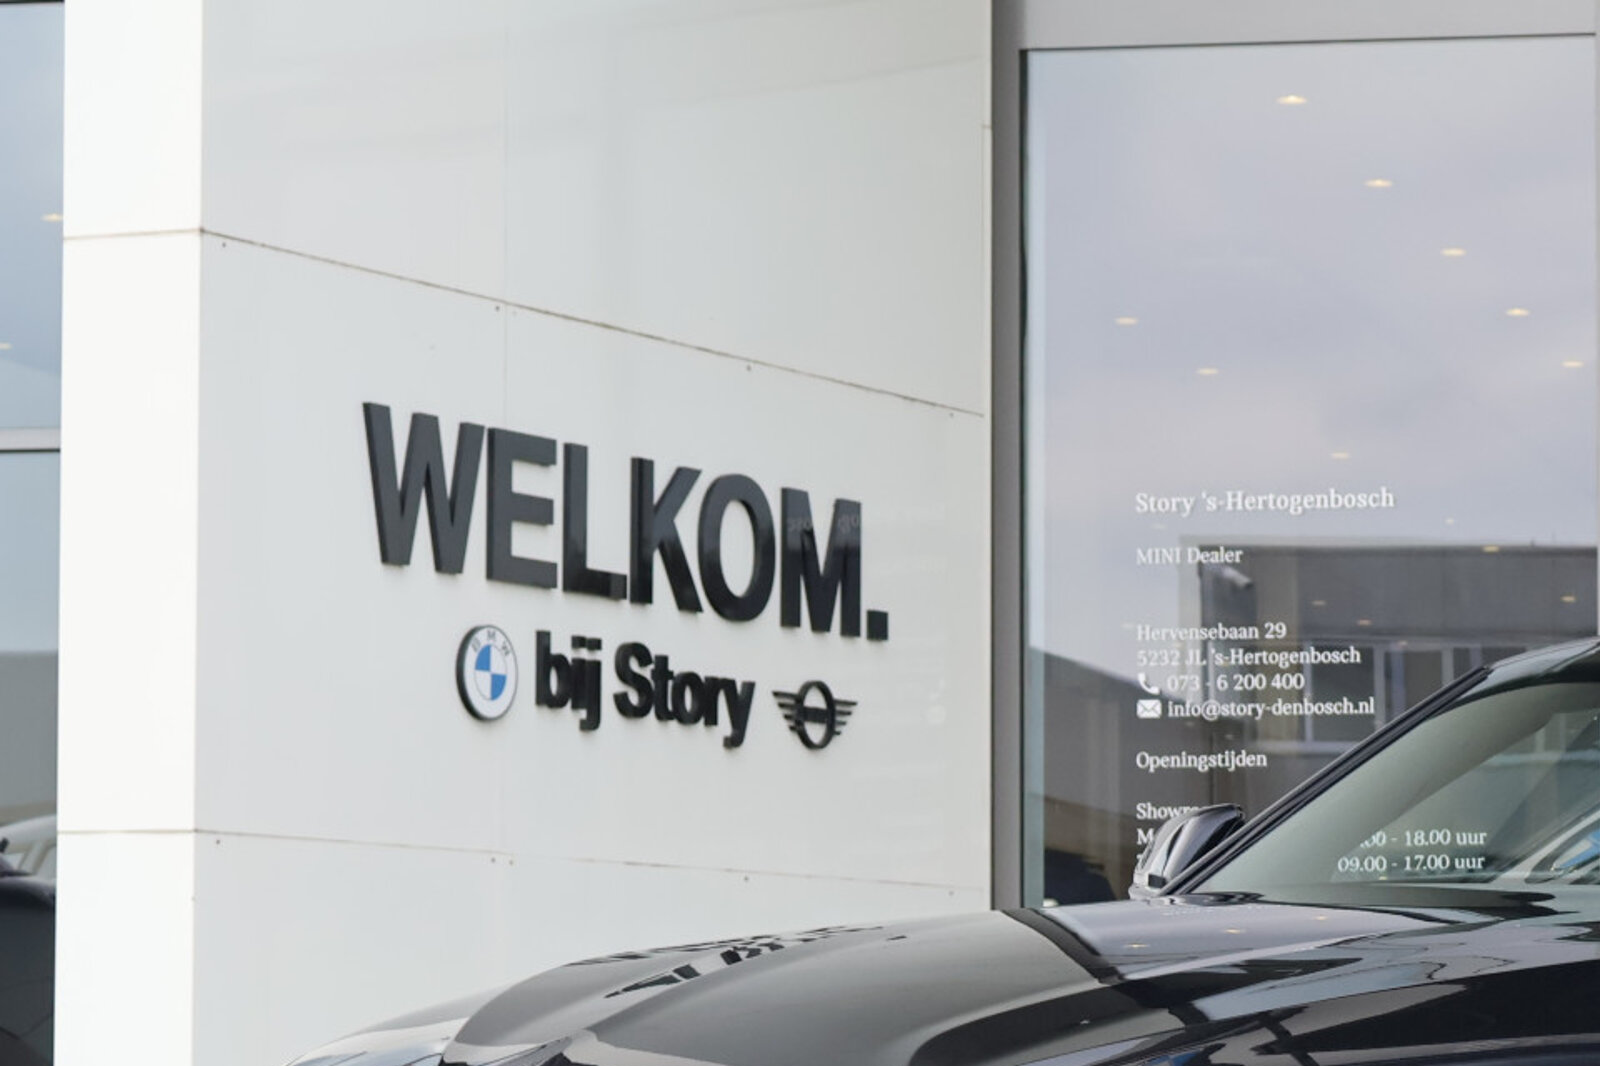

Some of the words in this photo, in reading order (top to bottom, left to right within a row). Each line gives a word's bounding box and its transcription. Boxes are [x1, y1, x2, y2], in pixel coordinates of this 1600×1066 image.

[1135, 492, 1196, 518] Story
[1201, 486, 1395, 515] 's-Hertogenbosch
[362, 401, 888, 641] WELKOM.
[1136, 547, 1182, 565] MINI
[1187, 546, 1243, 563] Dealer
[1137, 622, 1259, 641] Hervensebaan
[1264, 621, 1287, 639] 29
[1137, 650, 1180, 667] 5232
[1185, 649, 1207, 666] JL
[1211, 645, 1361, 669] 's-Hertogenbosch
[536, 630, 602, 731] bij
[612, 641, 755, 748] Story
[1166, 674, 1200, 693] 073
[1216, 674, 1229, 692] 6
[1233, 673, 1267, 691] 200
[1271, 672, 1305, 690] 400
[1168, 696, 1375, 721] info@story-denbosch.nl
[1136, 751, 1267, 772] Openingstijden
[1404, 828, 1450, 847] 18.00
[1456, 832, 1487, 846] uur
[1337, 855, 1387, 873] 09.00
[1403, 854, 1450, 871] 17.00
[1454, 857, 1485, 870] uur
